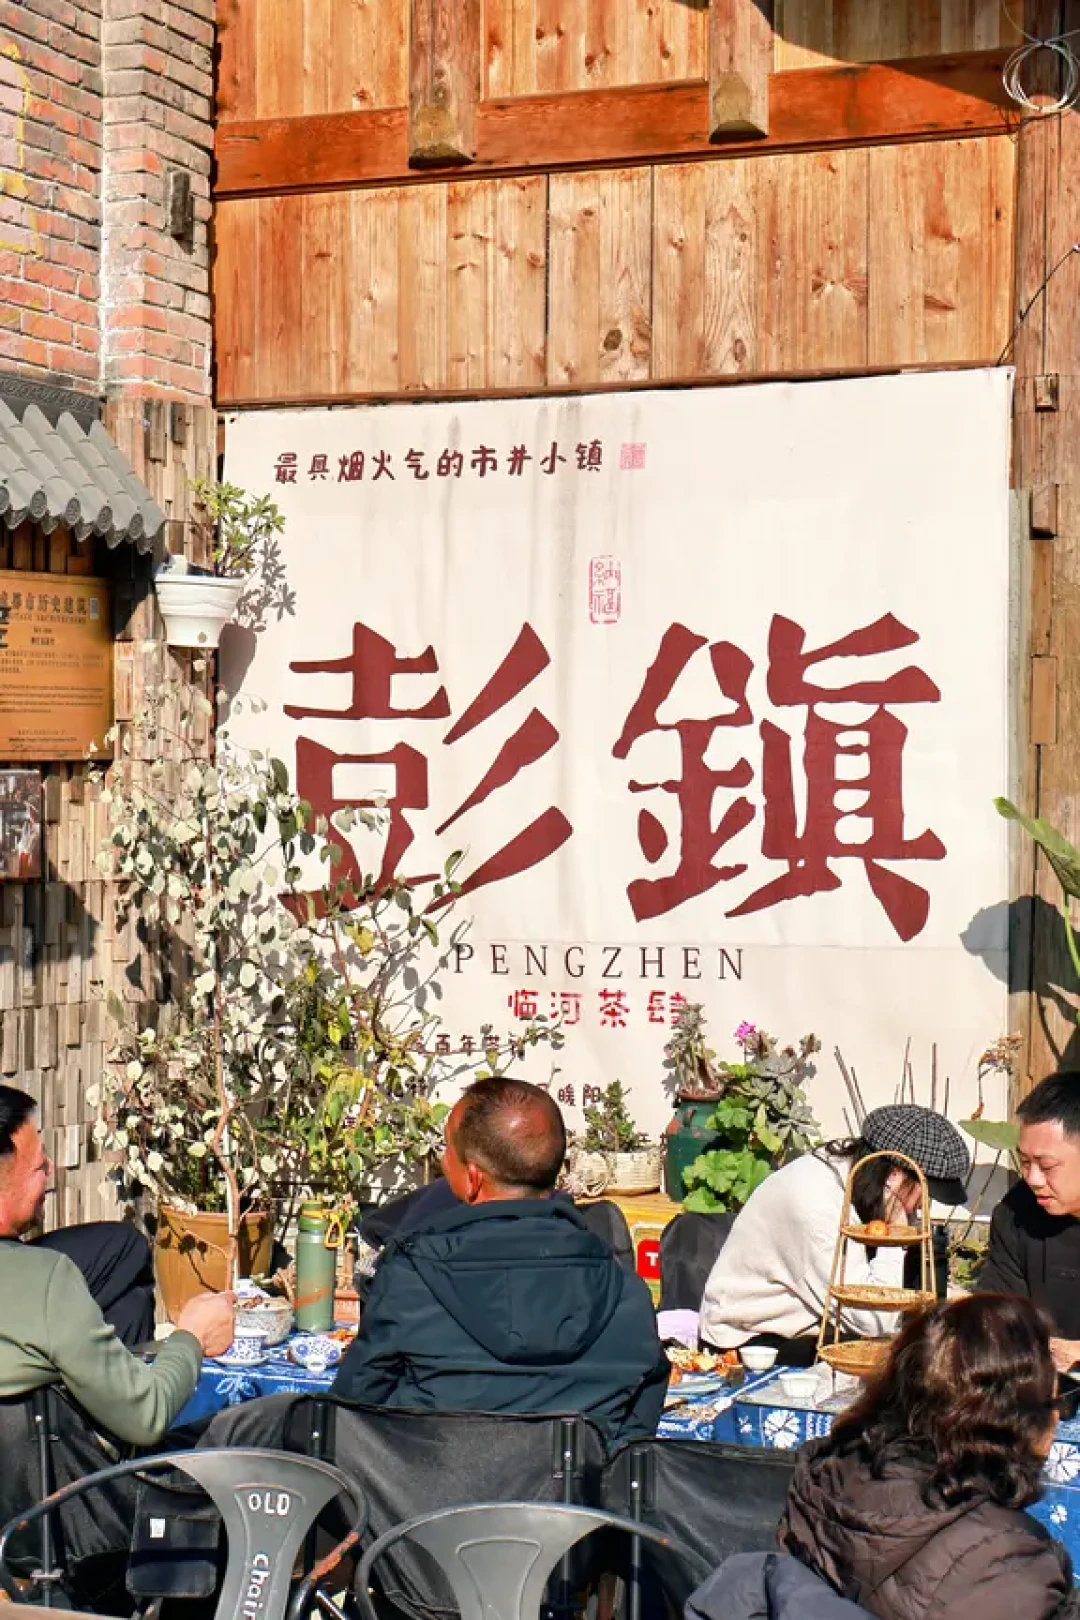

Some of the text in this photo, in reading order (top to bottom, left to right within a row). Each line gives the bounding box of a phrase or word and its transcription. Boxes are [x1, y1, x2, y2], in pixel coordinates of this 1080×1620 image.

[273, 440, 603, 484] 最具烟火气的市井小镇
[454, 943, 744, 980] PENGZHEN
[537, 1083, 602, 1106] 暖阳
[248, 1492, 290, 1516] OLD
